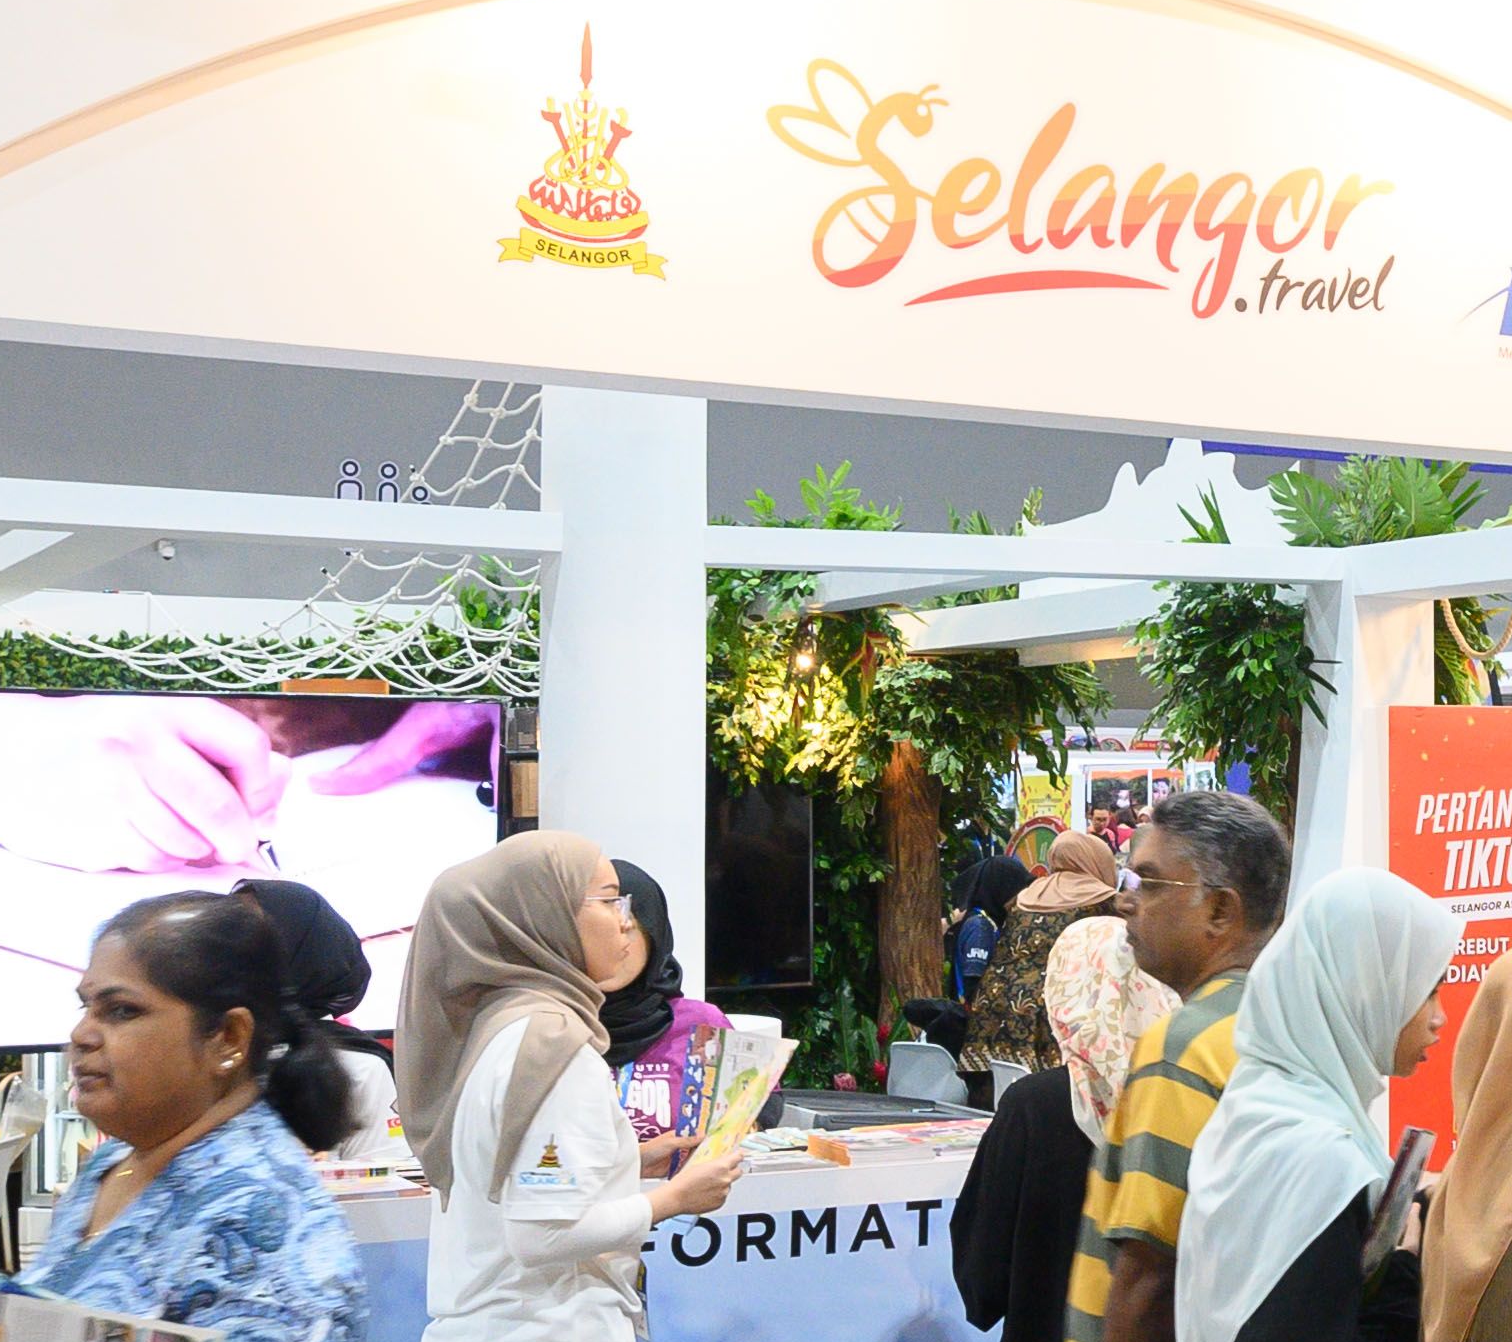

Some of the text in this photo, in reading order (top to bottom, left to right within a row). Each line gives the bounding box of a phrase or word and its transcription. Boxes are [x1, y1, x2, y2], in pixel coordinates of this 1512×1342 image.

[812, 89, 1397, 320] Selangor
[535, 239, 632, 264] SELANGOR
[1234, 254, 1396, 314] .travel
[1451, 901, 1502, 914] SELANGOR
[642, 1198, 942, 1267] ORMAT
